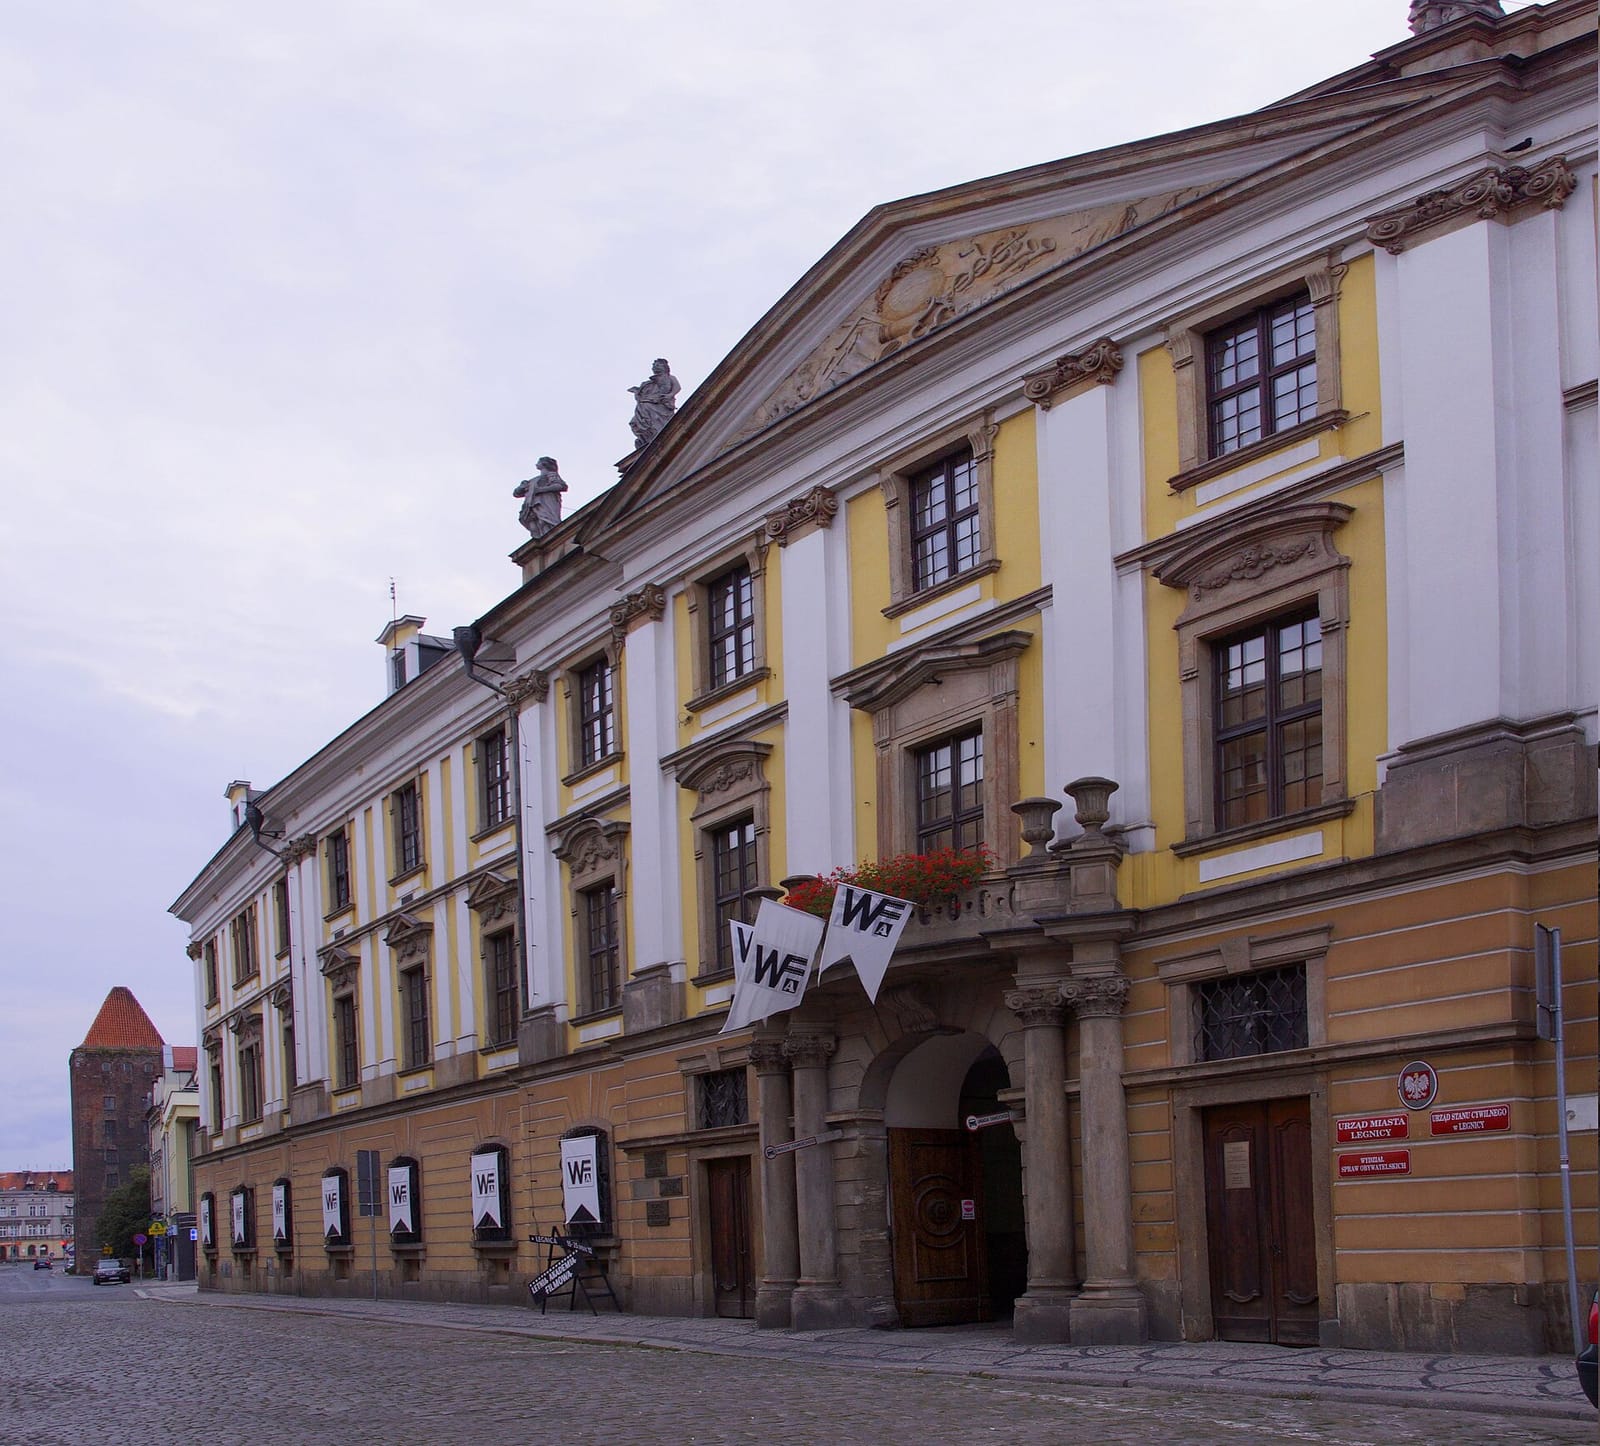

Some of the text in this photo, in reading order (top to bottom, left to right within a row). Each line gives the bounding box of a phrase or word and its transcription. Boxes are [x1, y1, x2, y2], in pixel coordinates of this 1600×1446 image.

[1338, 1118, 1406, 1131] URZĄD MIASTA
[1458, 1120, 1485, 1131] LEGNICY
[1351, 1129, 1392, 1139] LEGNICY
